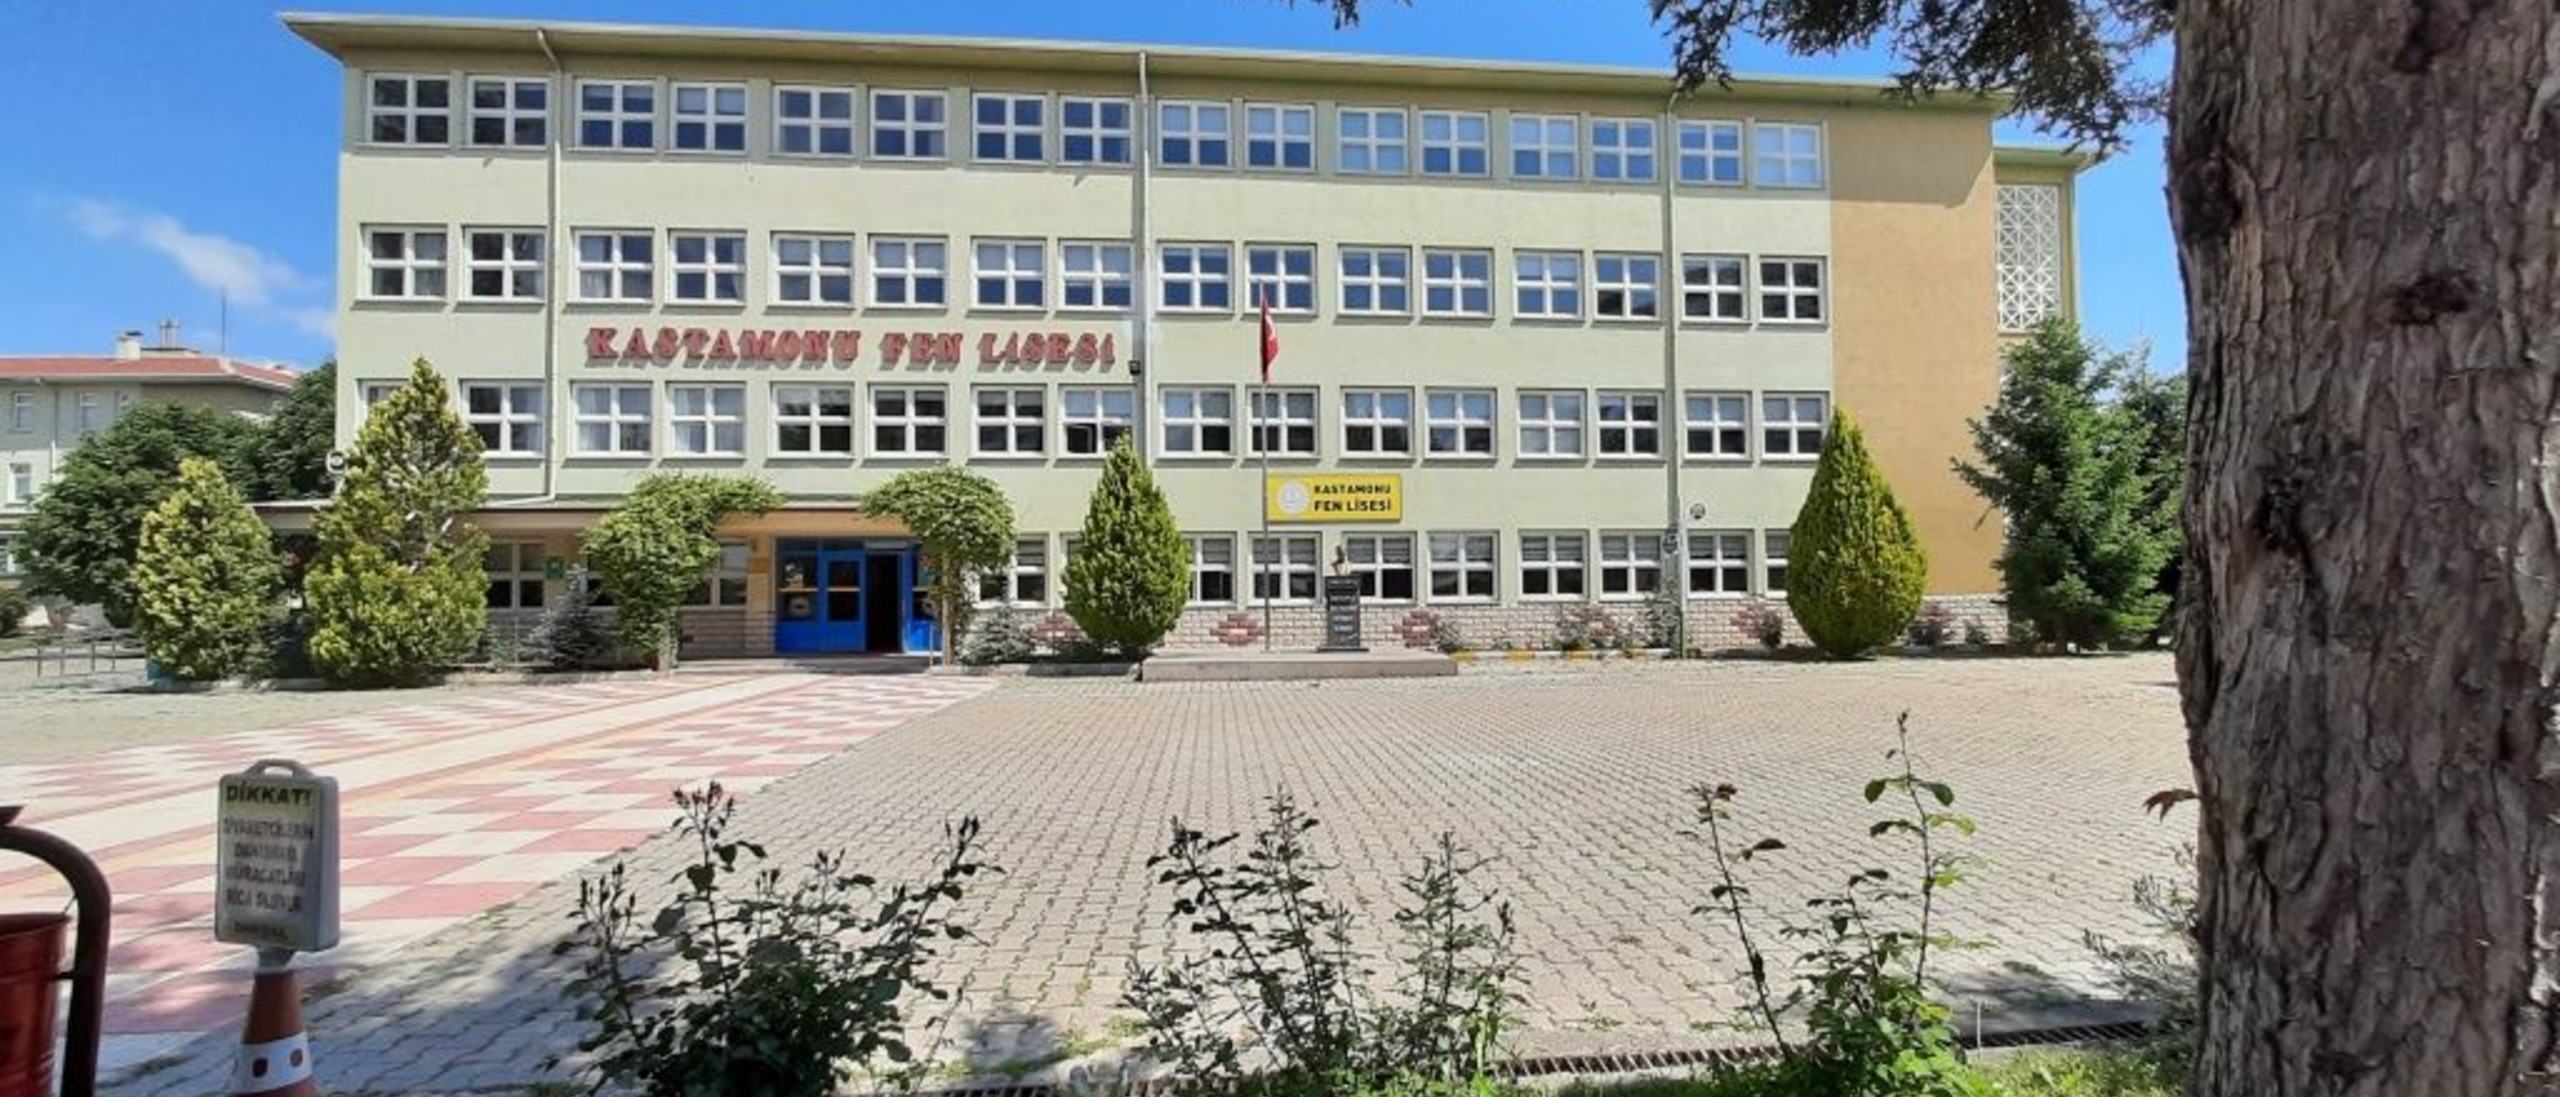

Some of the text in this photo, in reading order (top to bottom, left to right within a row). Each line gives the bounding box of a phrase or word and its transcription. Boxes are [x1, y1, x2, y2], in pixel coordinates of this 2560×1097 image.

[584, 327, 861, 362] KASTAMONU
[879, 332, 963, 364] FEN
[1314, 484, 1391, 495] KASTAMONU
[1314, 497, 1391, 512] FEN LİSESİ
[226, 781, 311, 806] DİKKAT!
